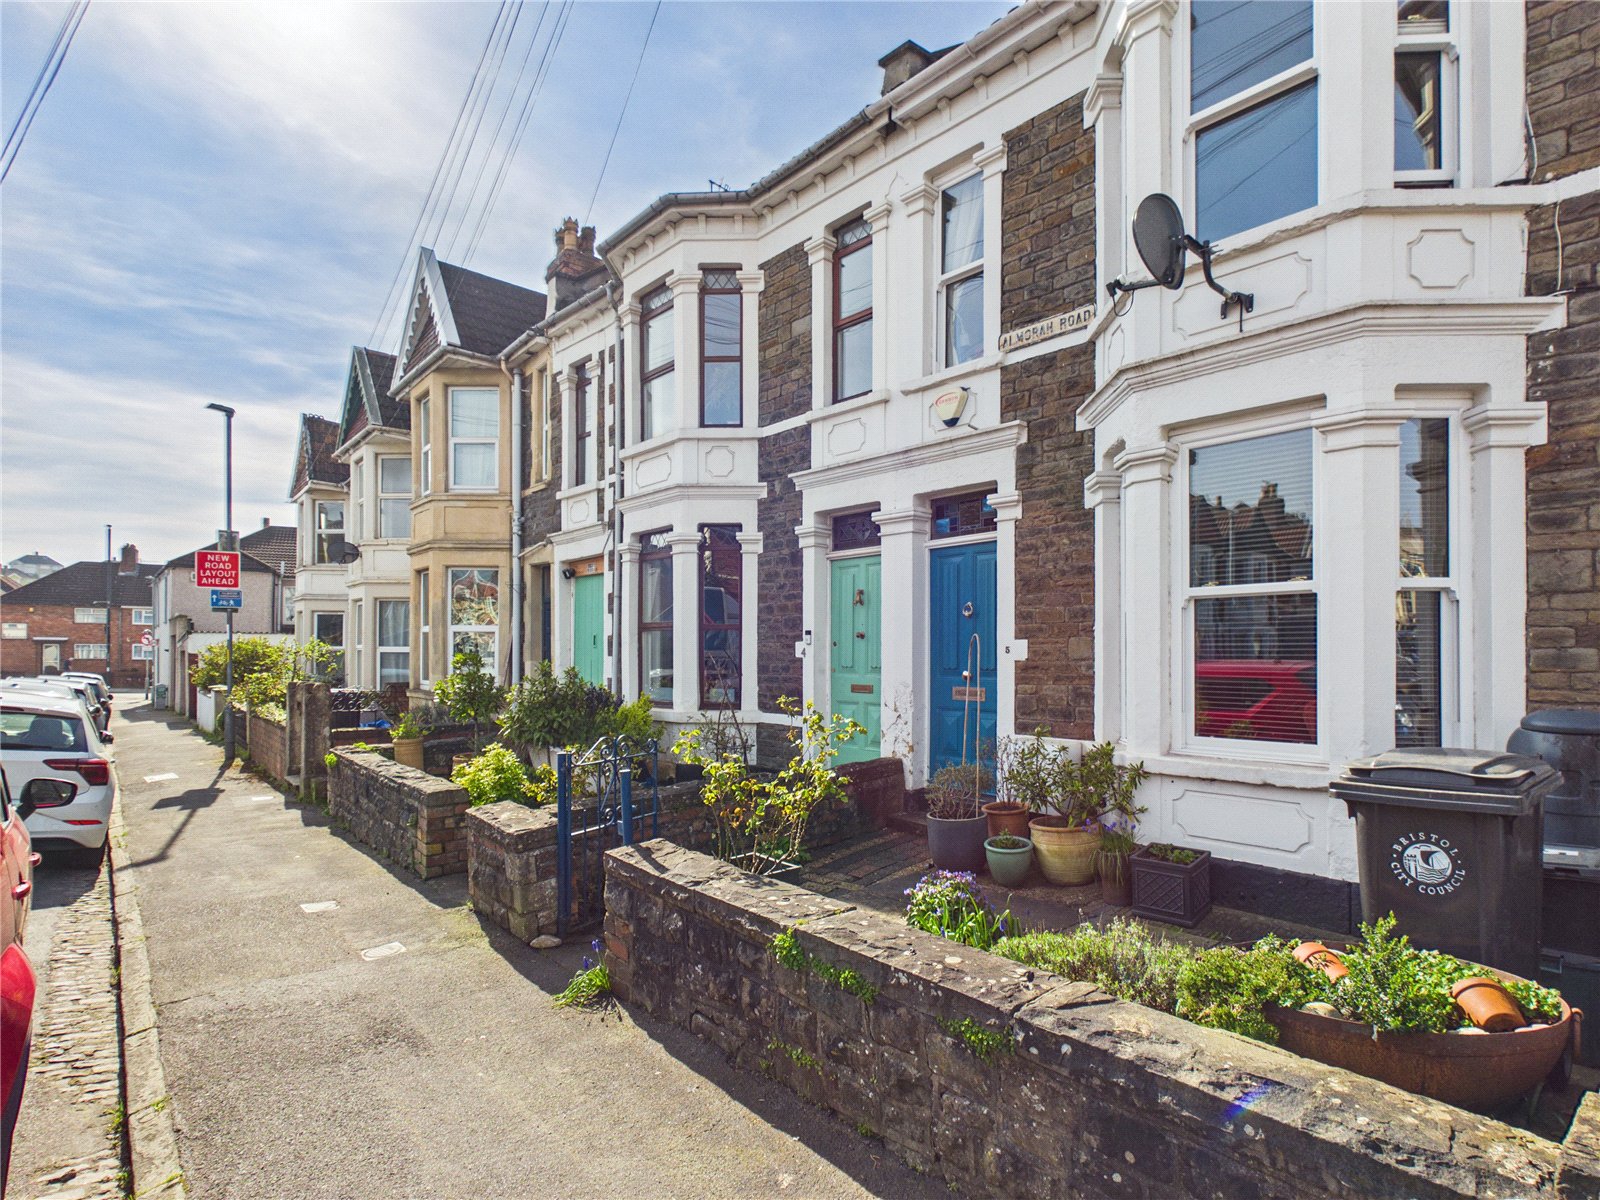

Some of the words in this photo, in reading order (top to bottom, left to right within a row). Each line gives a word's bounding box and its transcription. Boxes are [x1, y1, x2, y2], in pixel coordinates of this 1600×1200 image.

[1060, 309, 1091, 330] ROAD
[207, 554, 230, 562] NEW
[204, 562, 232, 570] ROAD
[200, 569, 237, 577] LAYOUT
[201, 577, 235, 585] AHEAD
[801, 647, 806, 658] 4
[1005, 646, 1010, 654] 5
[1392, 832, 1458, 856] BRISTOL
[1391, 862, 1414, 886] CITY
[1418, 869, 1466, 895] COUNCIL
